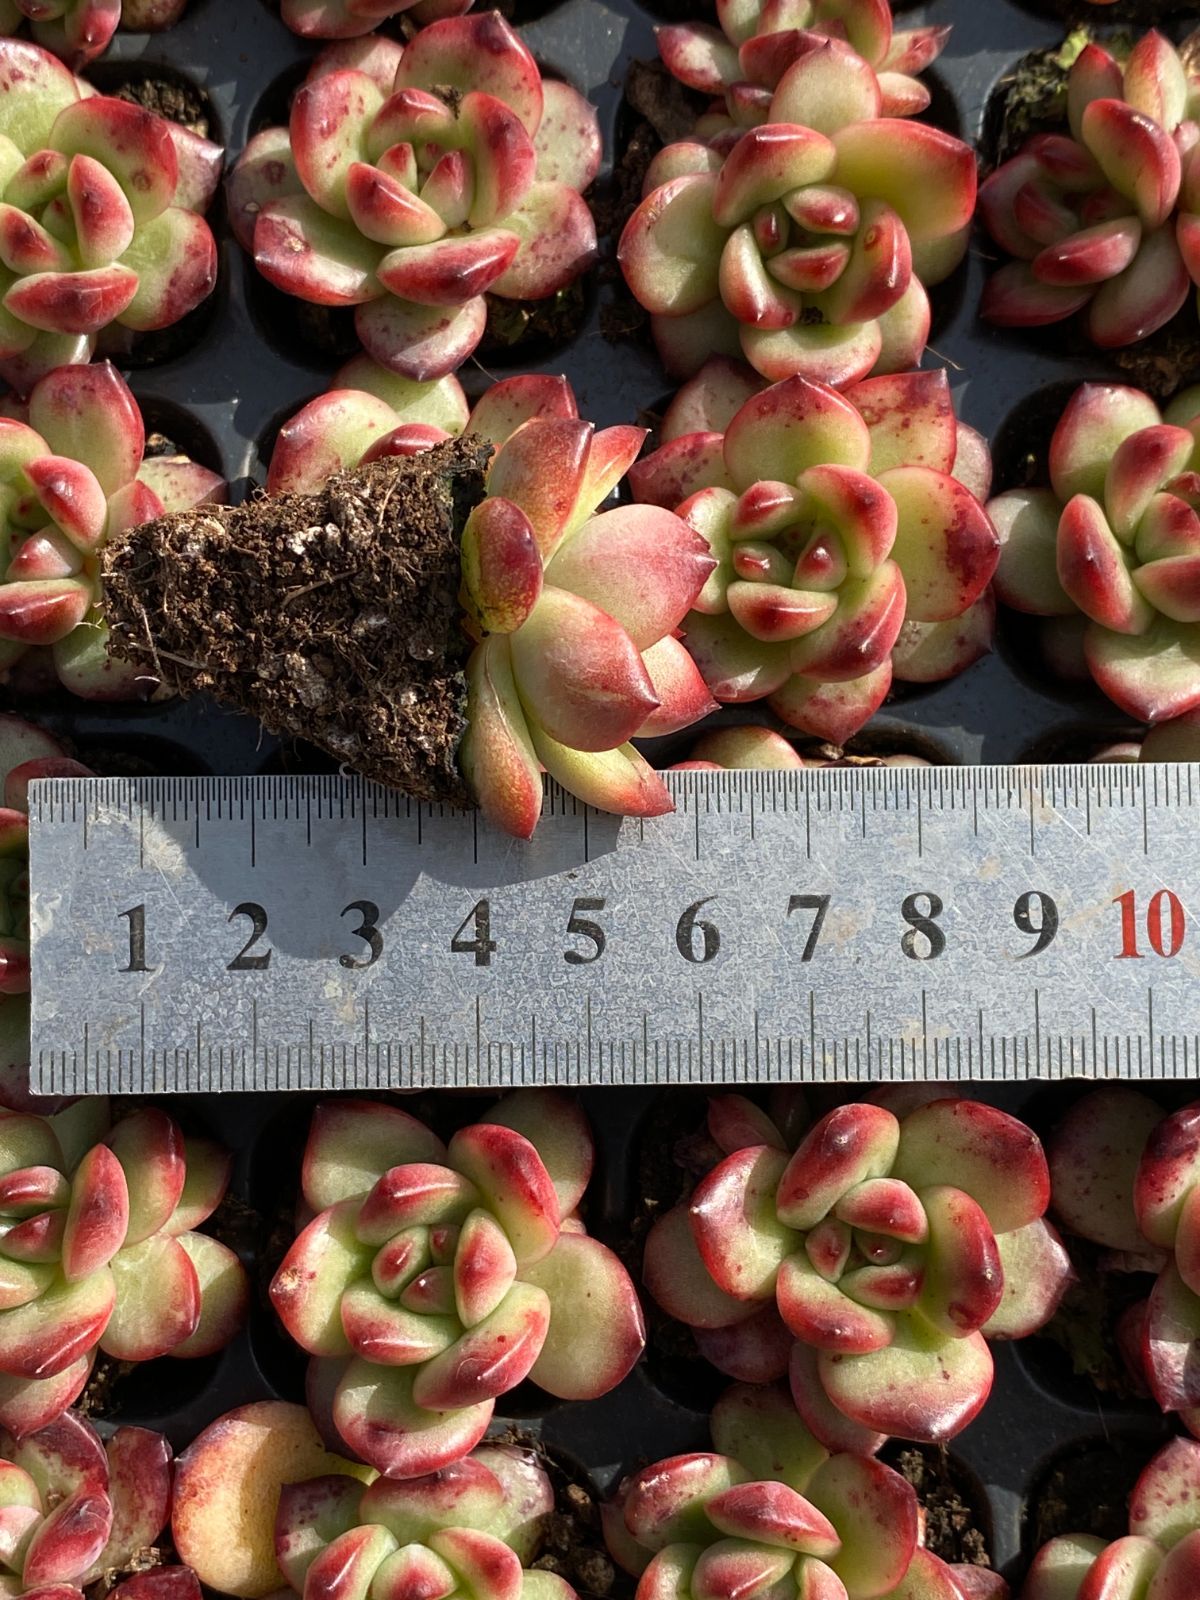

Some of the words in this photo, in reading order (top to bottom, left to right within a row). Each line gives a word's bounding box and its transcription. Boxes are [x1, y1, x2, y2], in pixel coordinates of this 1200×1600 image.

[118, 903, 154, 973] 1
[226, 901, 272, 971] 2
[338, 899, 384, 969] 3
[450, 899, 497, 967] 4
[563, 898, 607, 965] 5
[675, 896, 721, 964] 6
[787, 894, 832, 963] 7
[900, 892, 946, 961] 8
[1012, 890, 1059, 961] 9
[1112, 888, 1187, 960] 10
